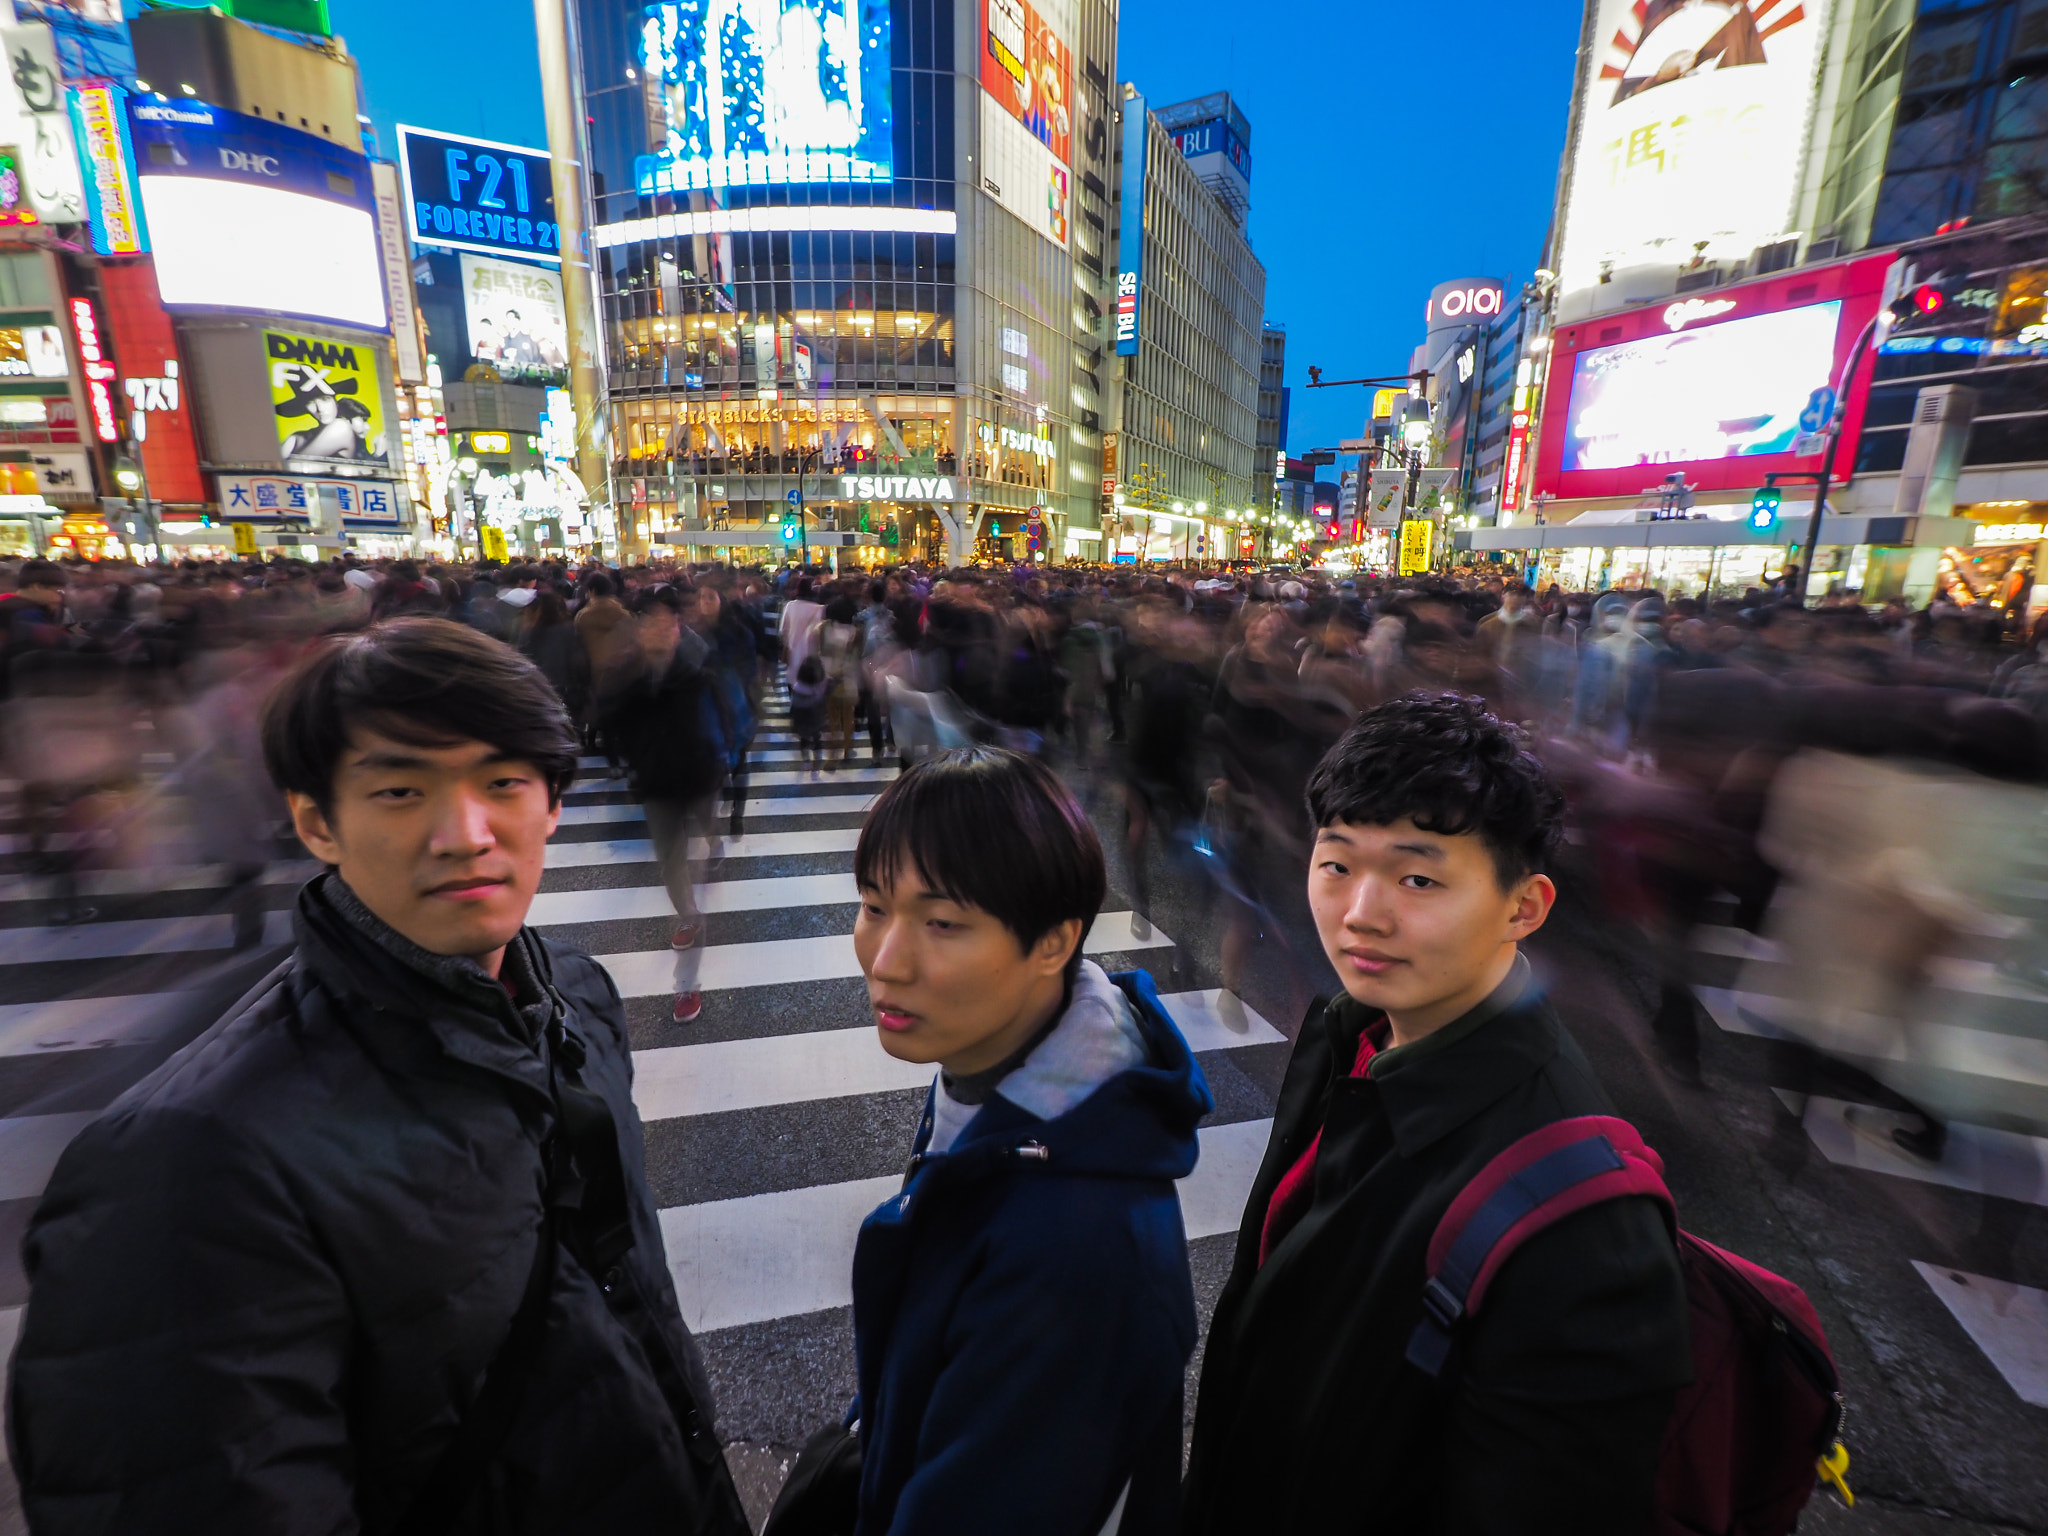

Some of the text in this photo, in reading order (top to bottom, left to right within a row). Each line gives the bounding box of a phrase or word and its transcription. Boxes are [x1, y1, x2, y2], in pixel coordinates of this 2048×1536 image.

[219, 147, 279, 176] DHC
[446, 148, 529, 213] F21
[416, 202, 561, 250] FOREVER 21
[472, 267, 556, 303] 有馬記念
[1117, 272, 1136, 340] SEIBU
[267, 333, 360, 371] DMM
[273, 362, 336, 395] FX
[677, 407, 866, 425] STARBUCKS COFFEE
[1001, 426, 1056, 459] TSUTAYA
[841, 476, 954, 499] TSUTAYA
